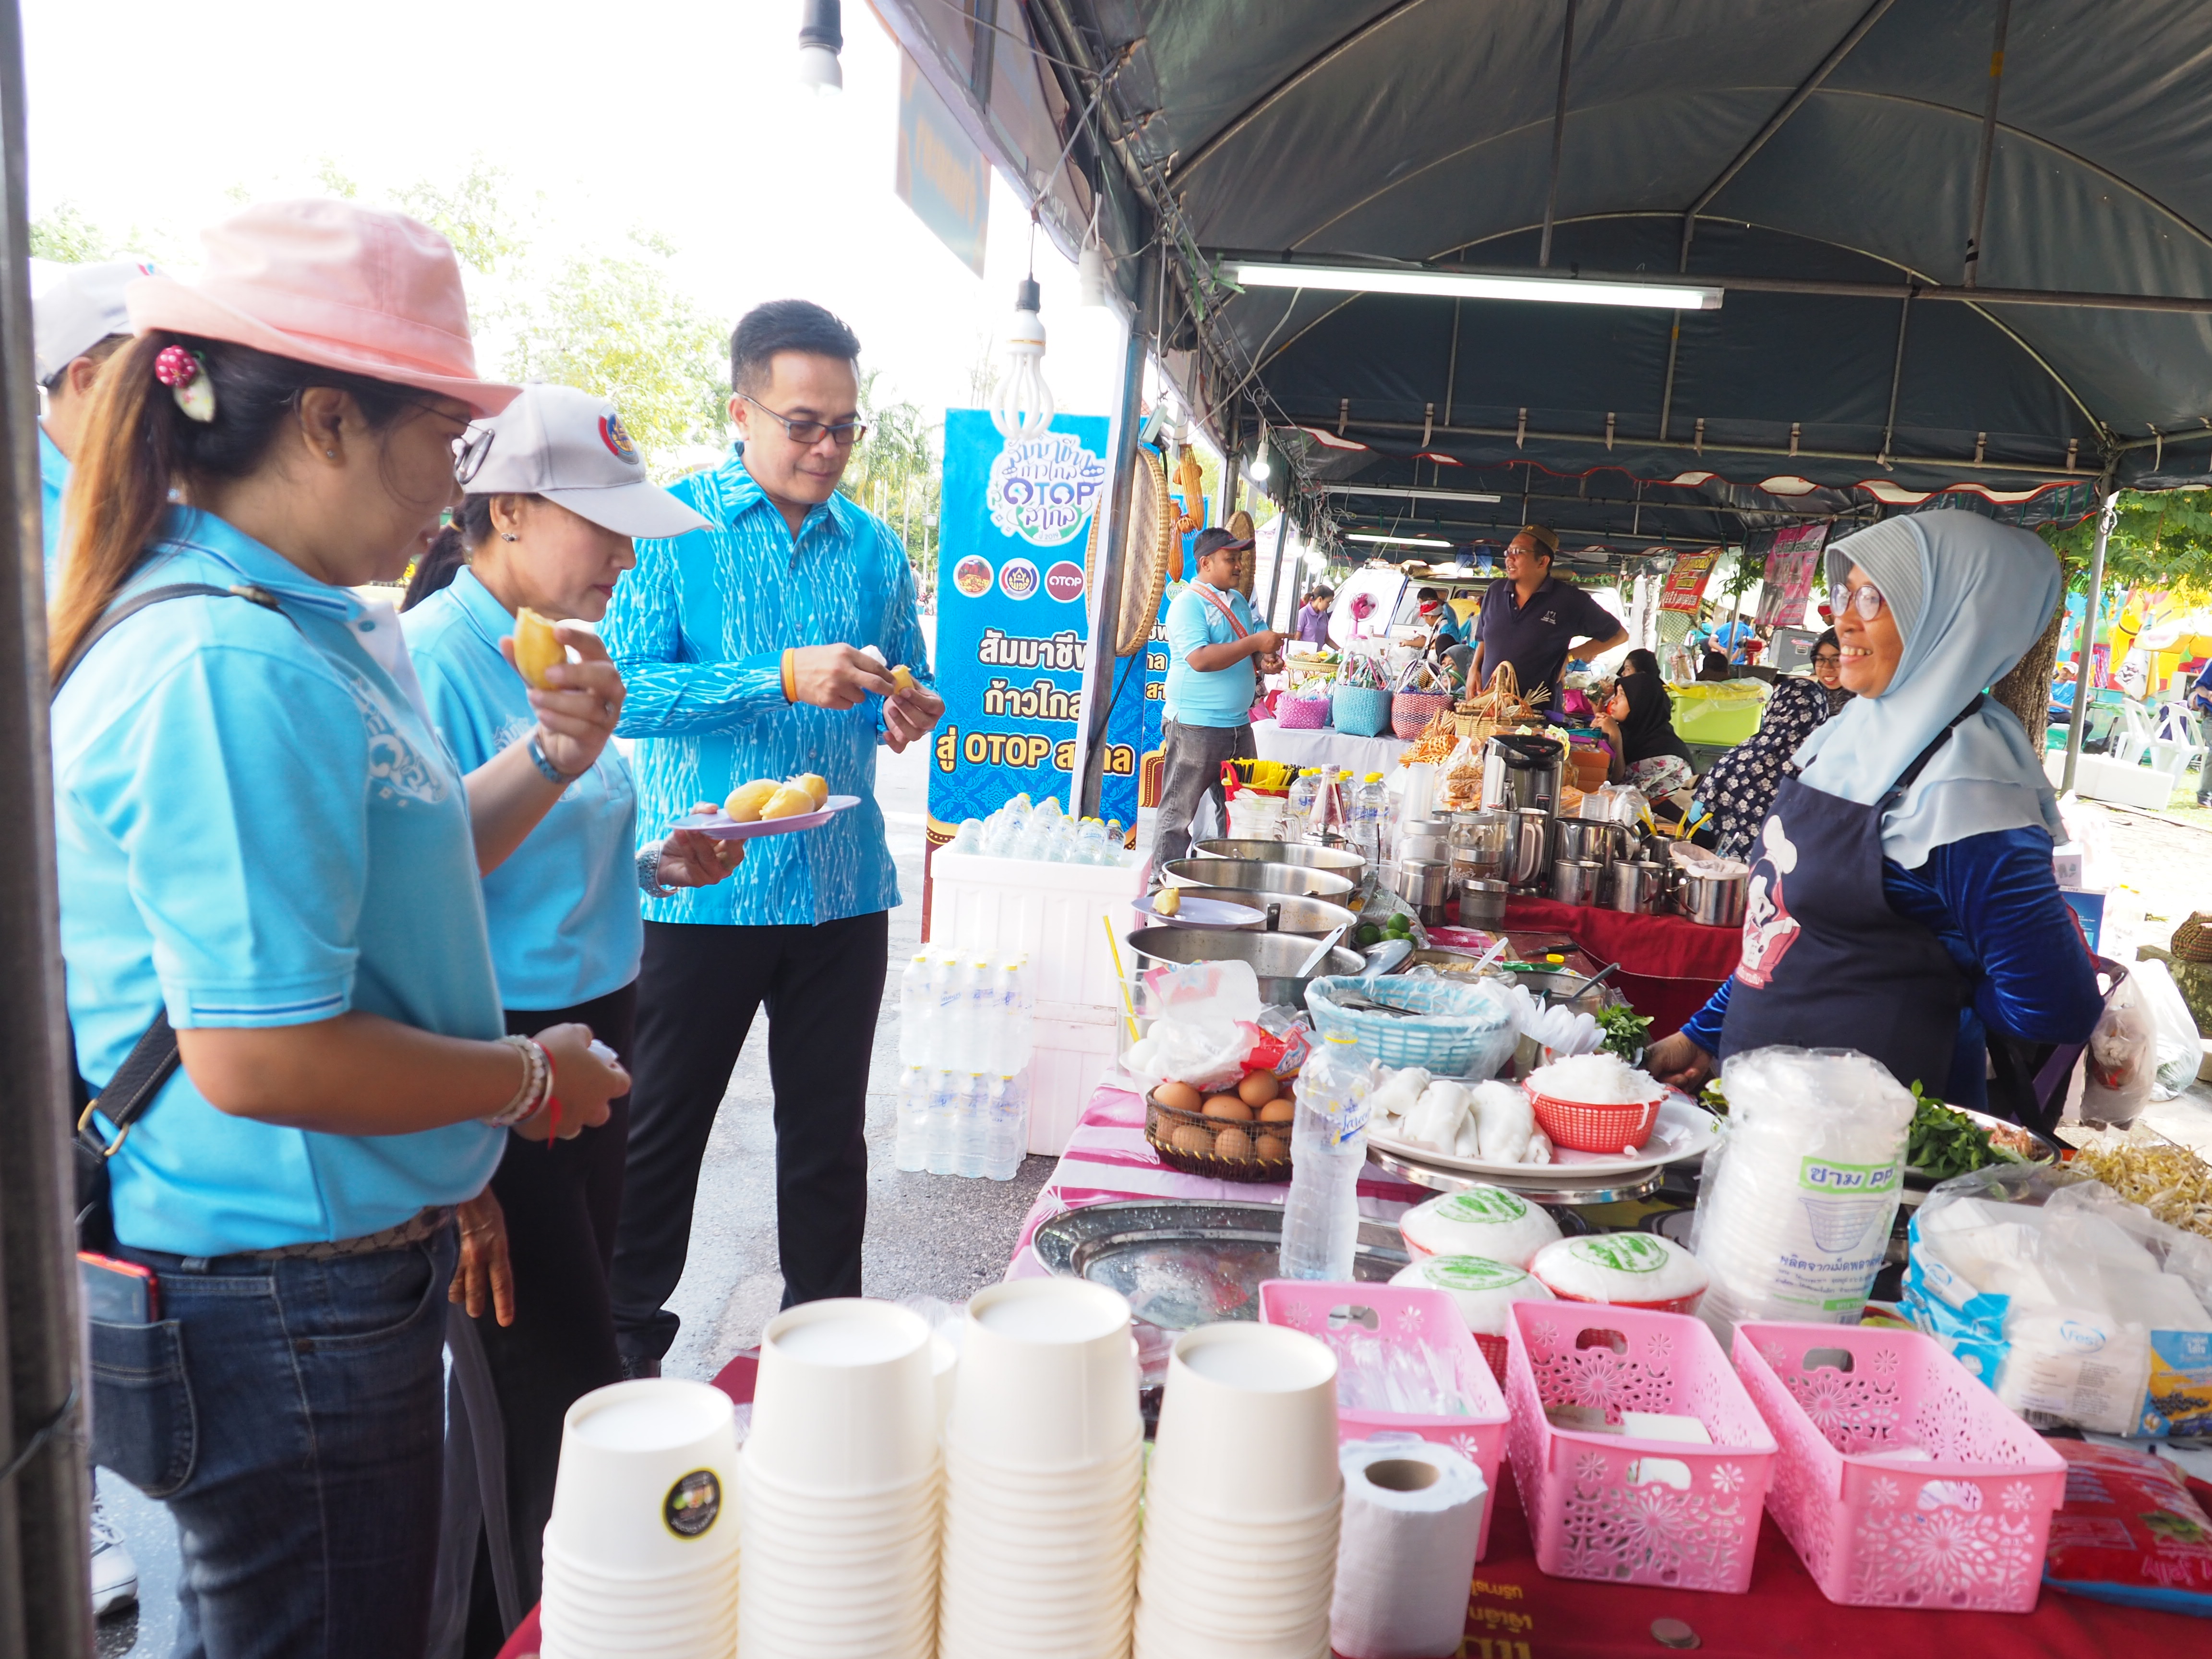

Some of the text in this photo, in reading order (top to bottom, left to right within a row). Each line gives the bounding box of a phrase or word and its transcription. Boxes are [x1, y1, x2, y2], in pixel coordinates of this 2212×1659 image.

[1003, 478, 1096, 505] OTOP
[1049, 575, 1082, 587] OTOP
[937, 727, 956, 771] สู่
[965, 734, 1048, 766] OTOP
